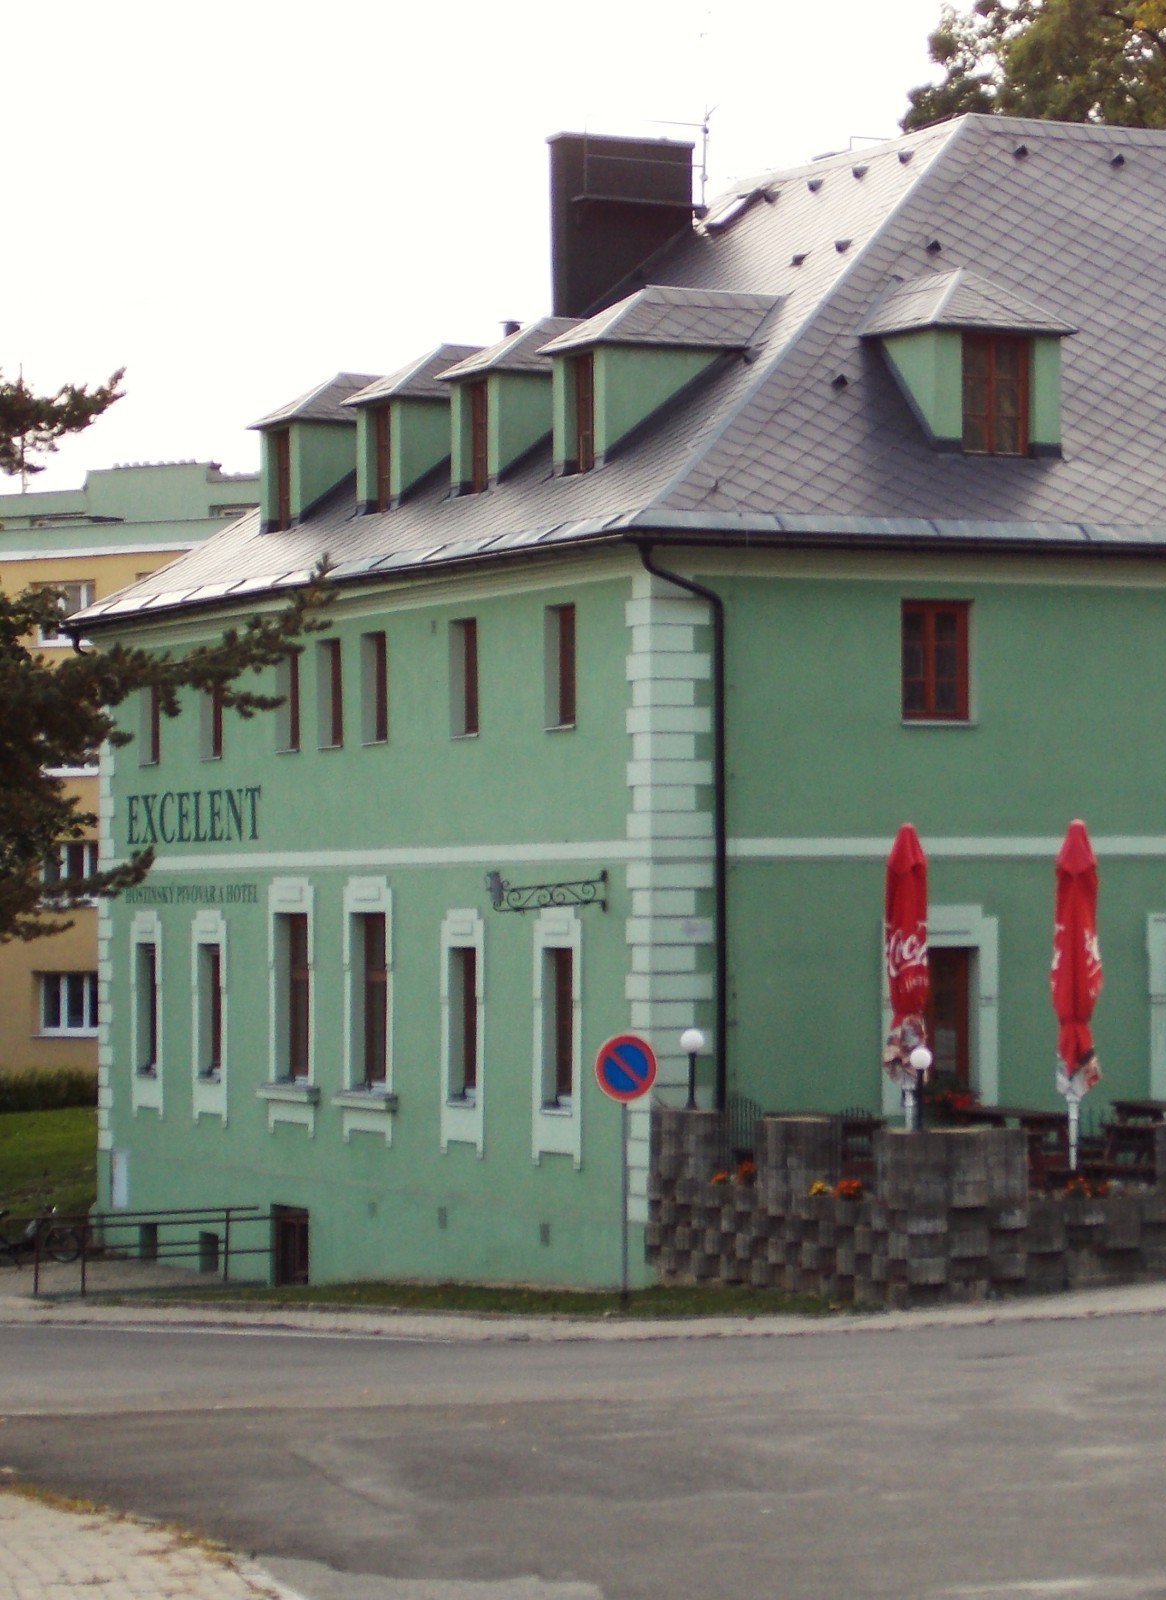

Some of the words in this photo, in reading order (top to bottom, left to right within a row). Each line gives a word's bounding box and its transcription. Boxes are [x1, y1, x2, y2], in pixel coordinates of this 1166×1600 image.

[126, 785, 261, 844] EXCELENT
[176, 883, 216, 903] PIVOVAR
[225, 882, 258, 903] HOTEL
